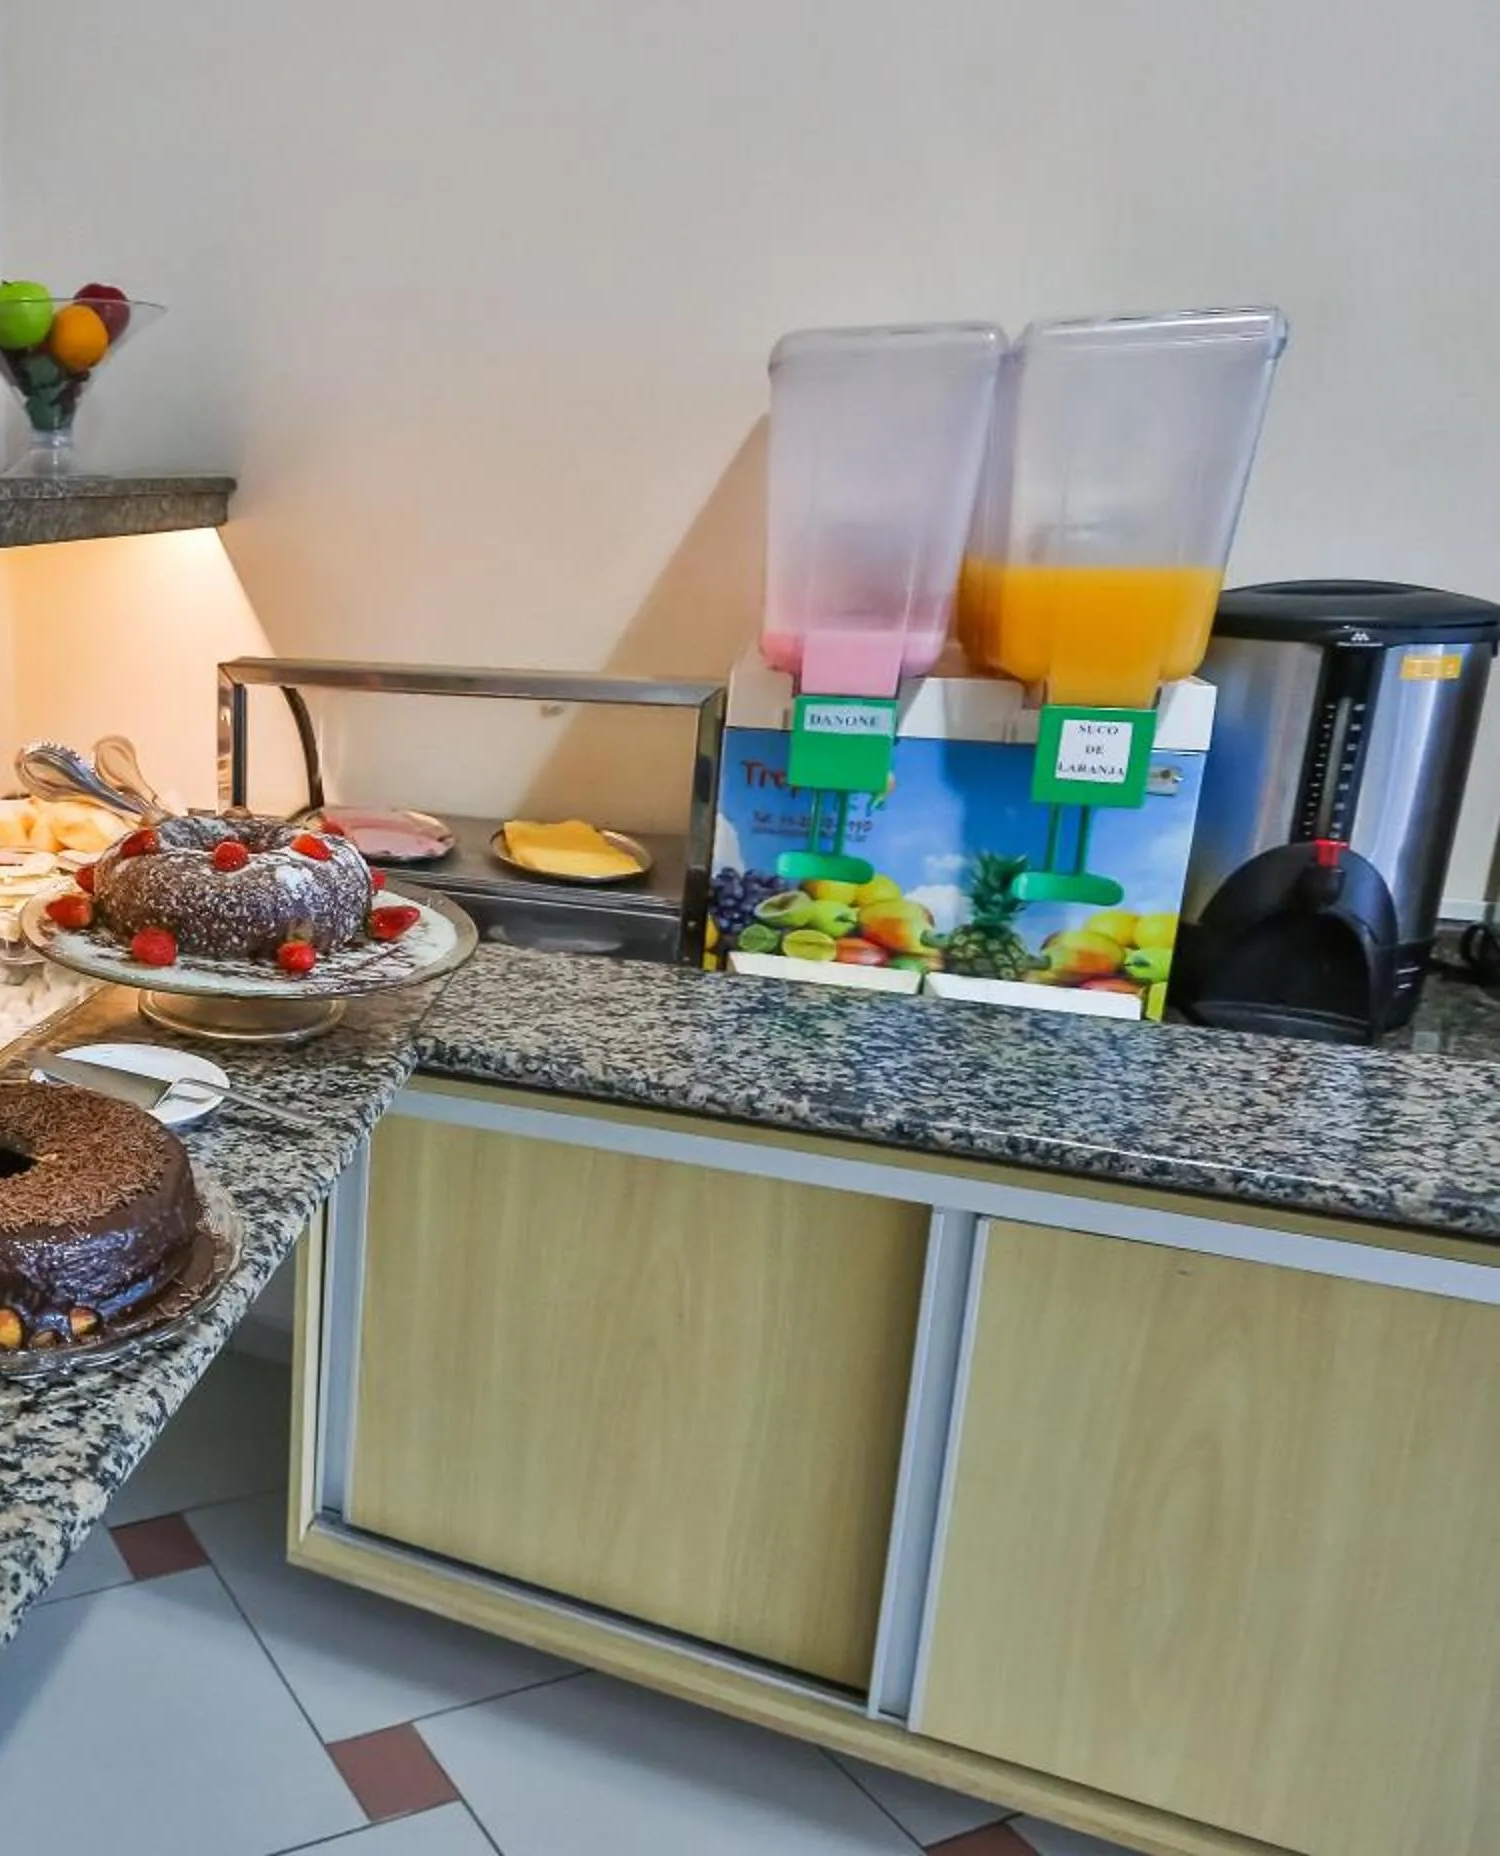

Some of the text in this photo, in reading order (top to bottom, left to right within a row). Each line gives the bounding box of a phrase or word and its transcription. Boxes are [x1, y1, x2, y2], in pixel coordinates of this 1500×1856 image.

[809, 712, 879, 729] DANONE
[1078, 724, 1120, 736] SUCO
[1084, 744, 1106, 755] DE
[1058, 762, 1125, 776] LARANJA
